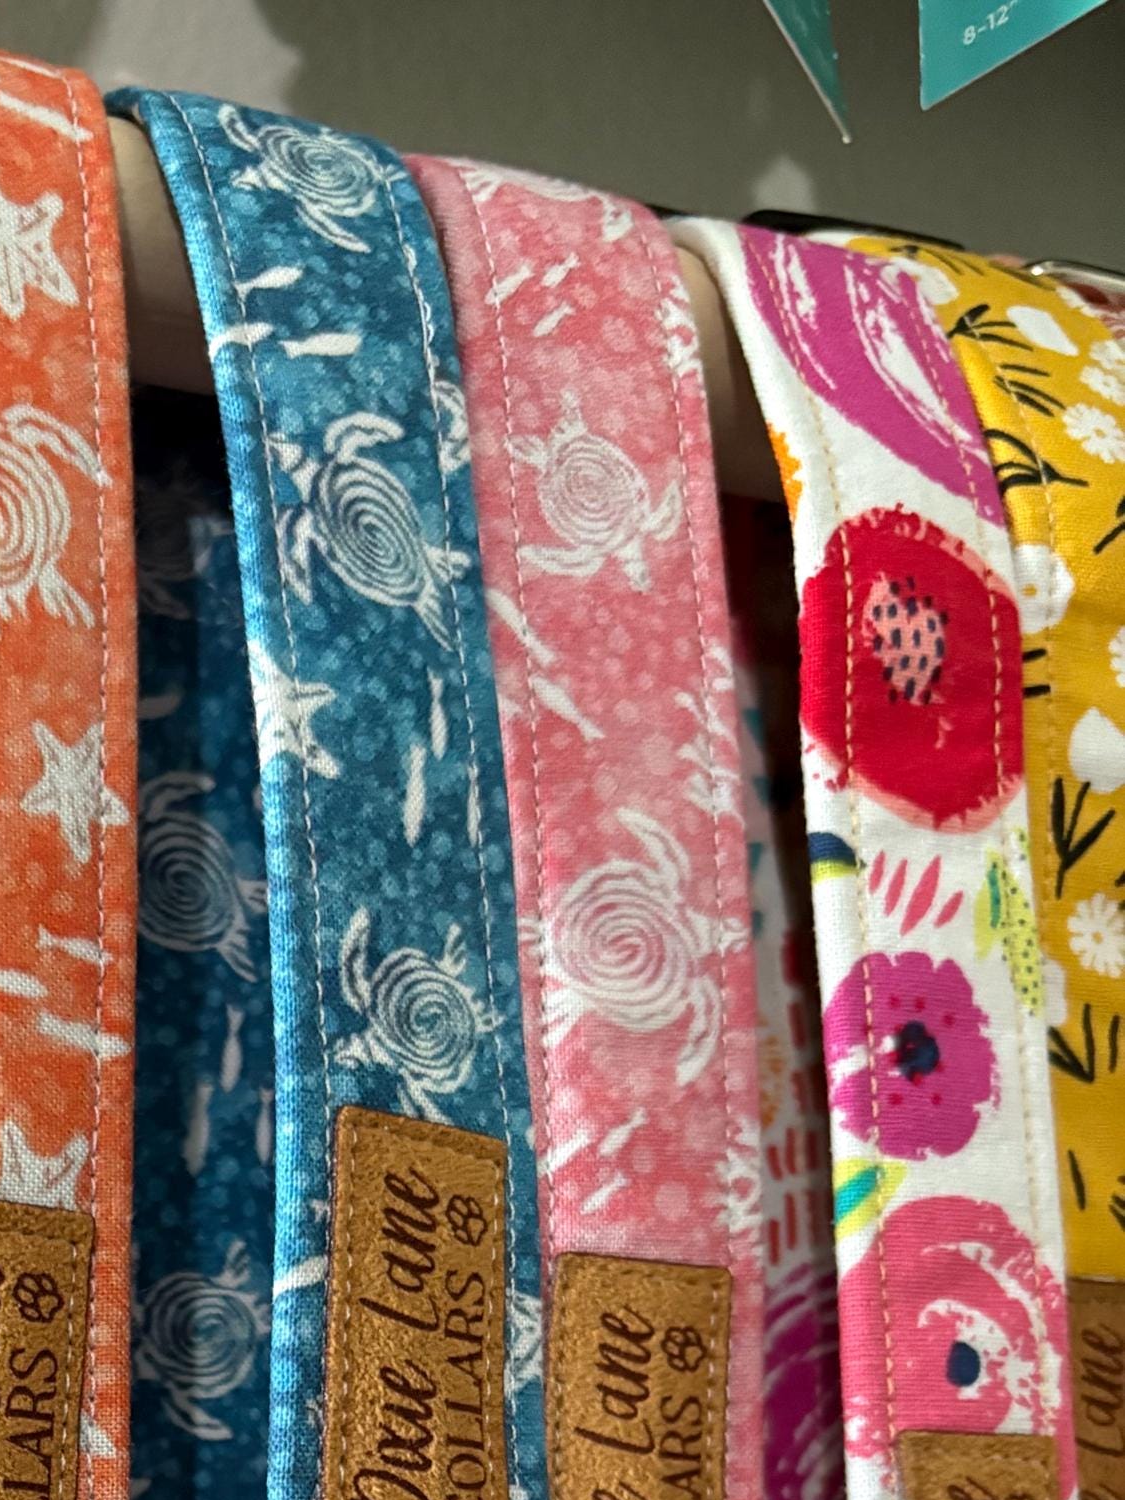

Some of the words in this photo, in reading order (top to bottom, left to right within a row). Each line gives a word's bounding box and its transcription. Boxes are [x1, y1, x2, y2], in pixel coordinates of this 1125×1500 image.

[359, 1166, 442, 1335] Lane
[576, 1303, 657, 1458] Lane
[1075, 1321, 1125, 1458] Lane
